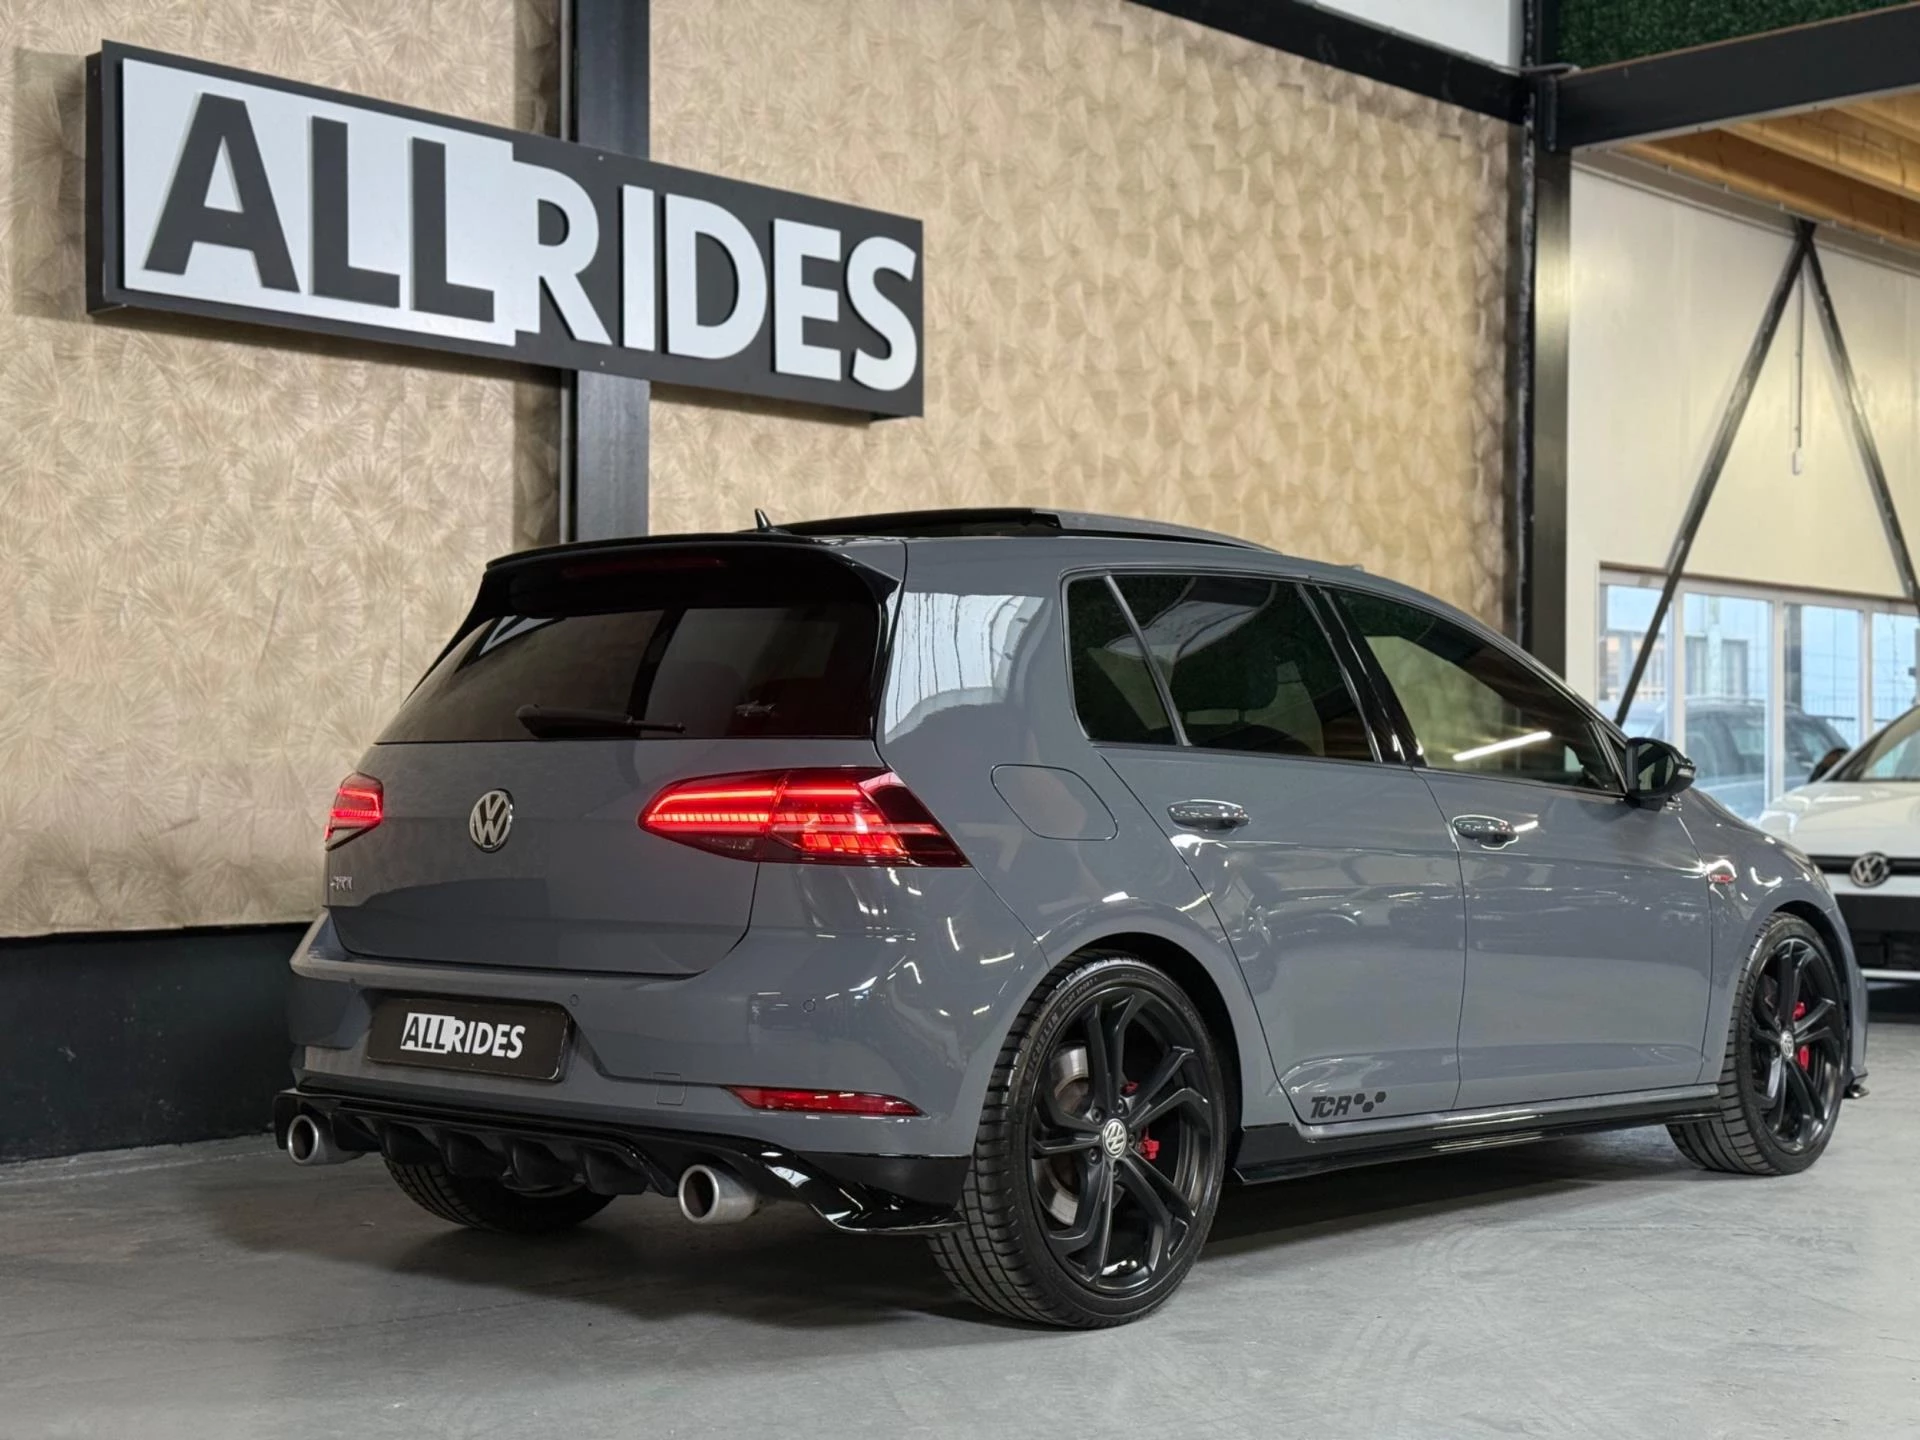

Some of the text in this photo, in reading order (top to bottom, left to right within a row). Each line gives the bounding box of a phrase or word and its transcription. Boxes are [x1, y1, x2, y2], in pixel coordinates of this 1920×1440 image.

[143, 92, 918, 392] ALLRIDES
[469, 788, 513, 852] VW
[401, 1014, 526, 1059] ALLRIDES
[1310, 1095, 1352, 1119] TCR
